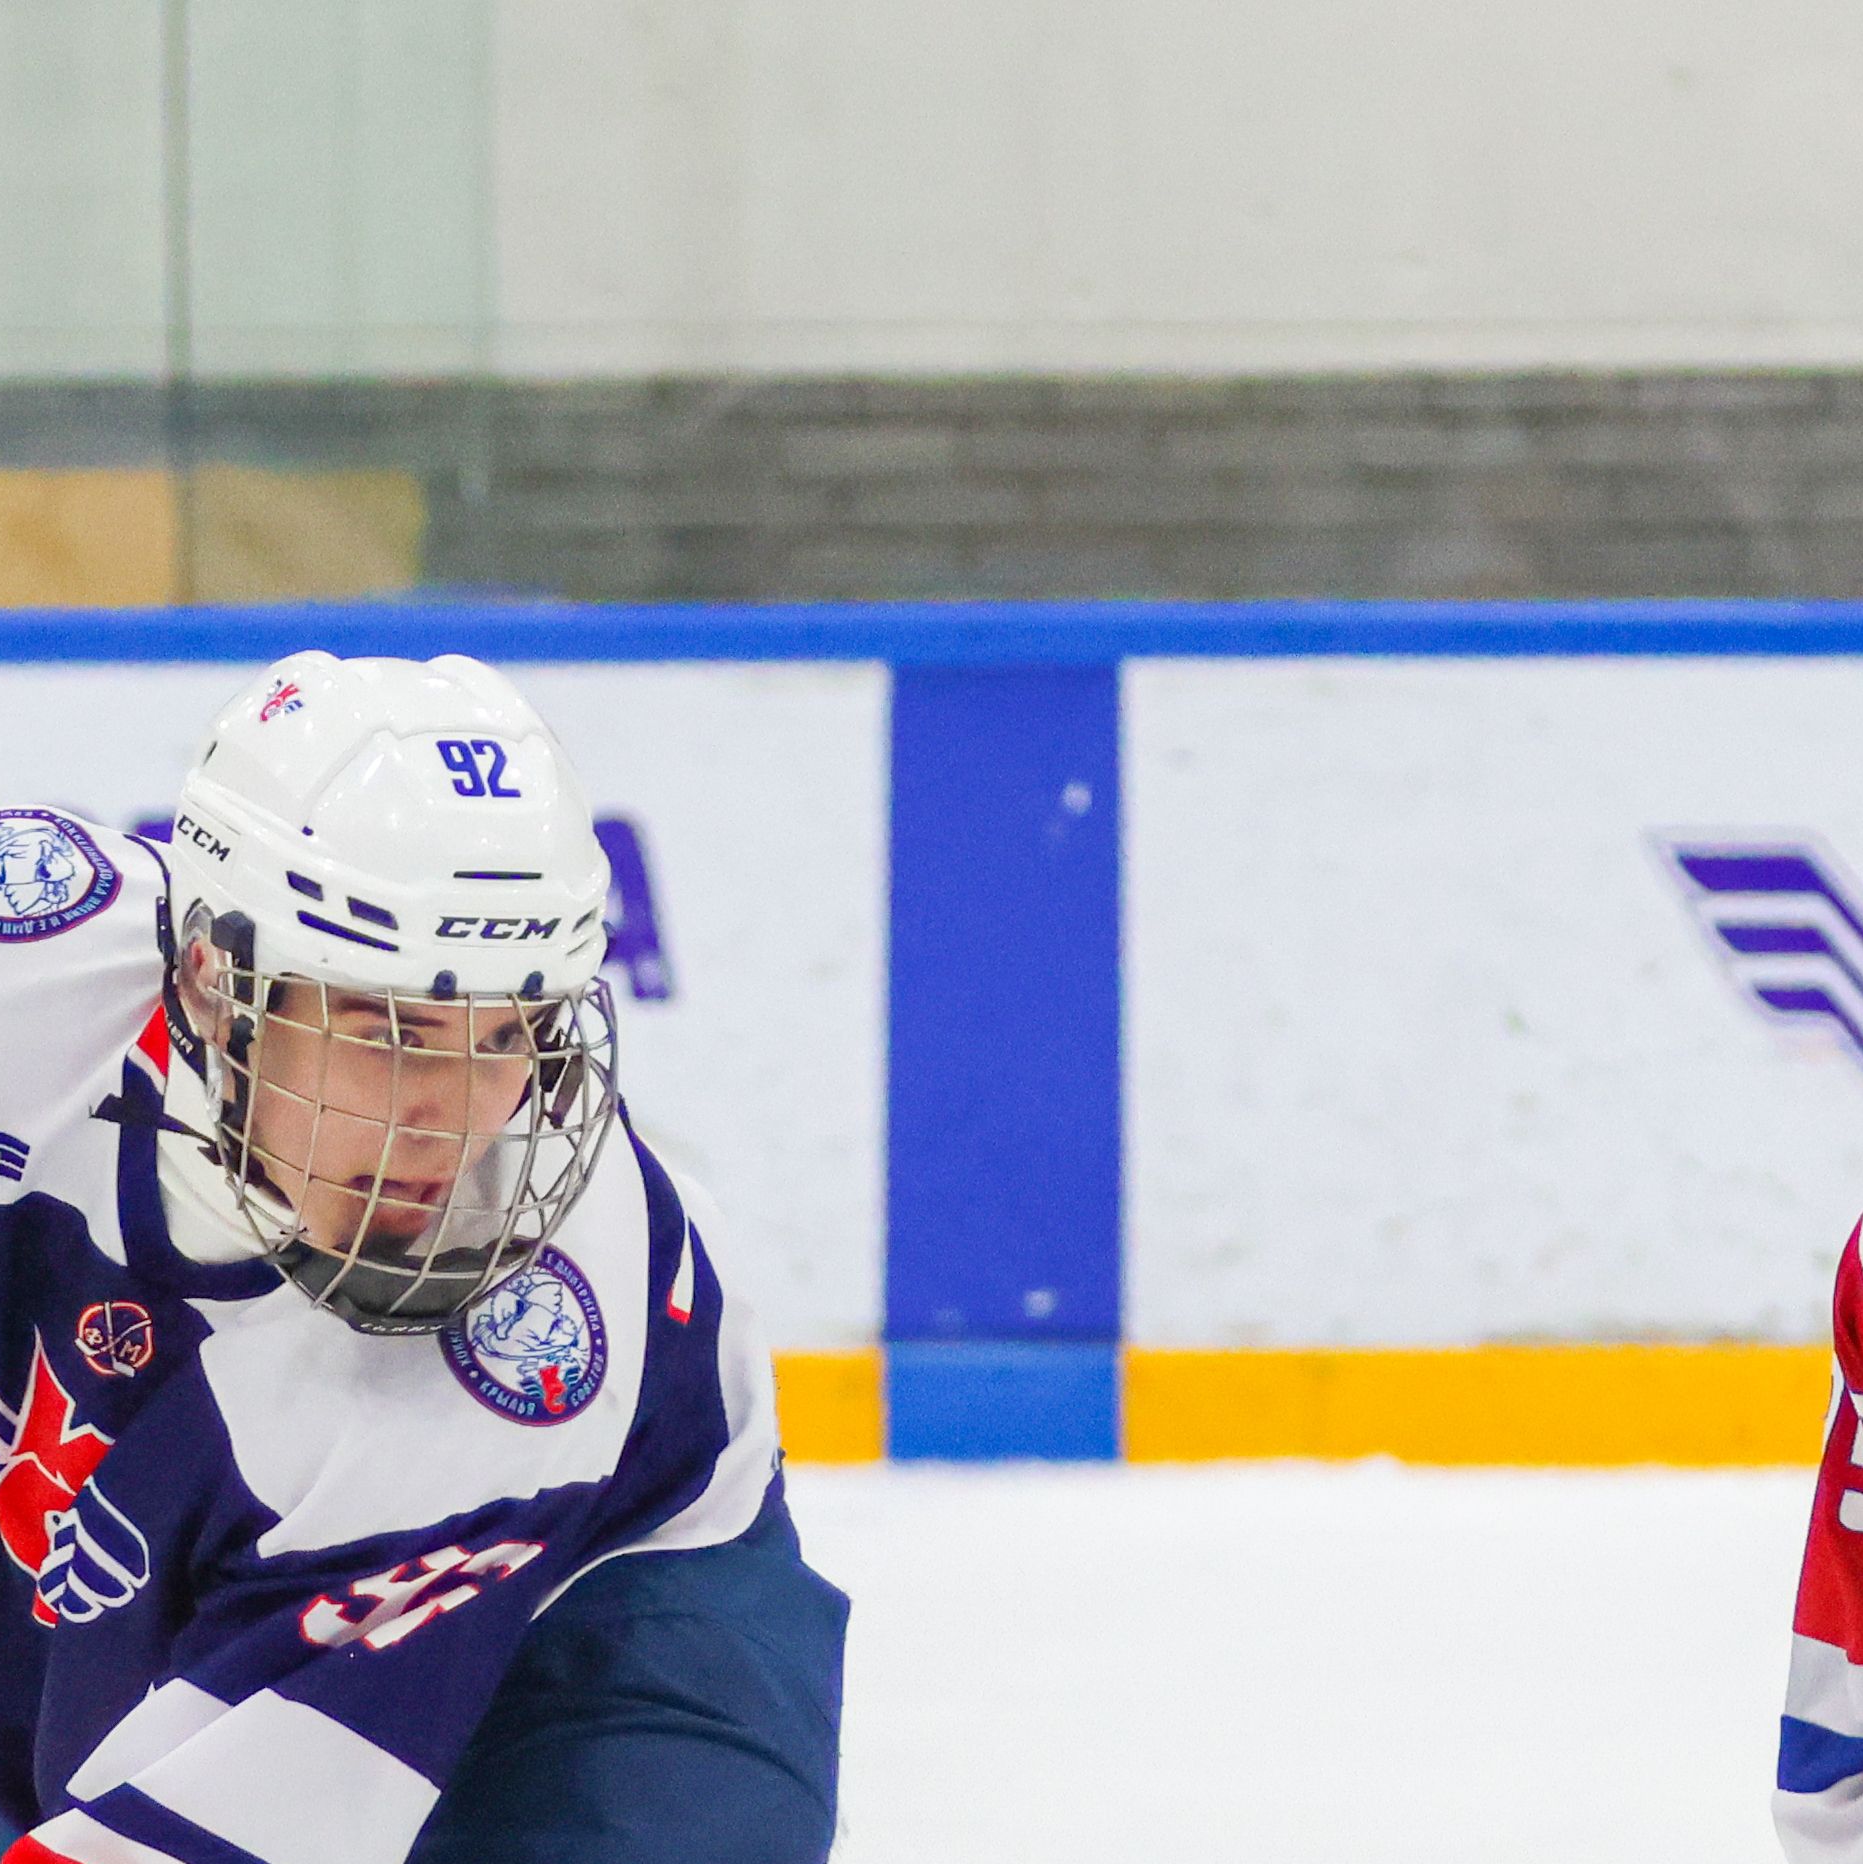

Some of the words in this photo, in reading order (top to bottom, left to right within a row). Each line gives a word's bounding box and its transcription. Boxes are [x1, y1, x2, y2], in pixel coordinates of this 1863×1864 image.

[436, 738, 522, 799] 92
[175, 813, 231, 865] CCM
[435, 914, 562, 942] CCM
